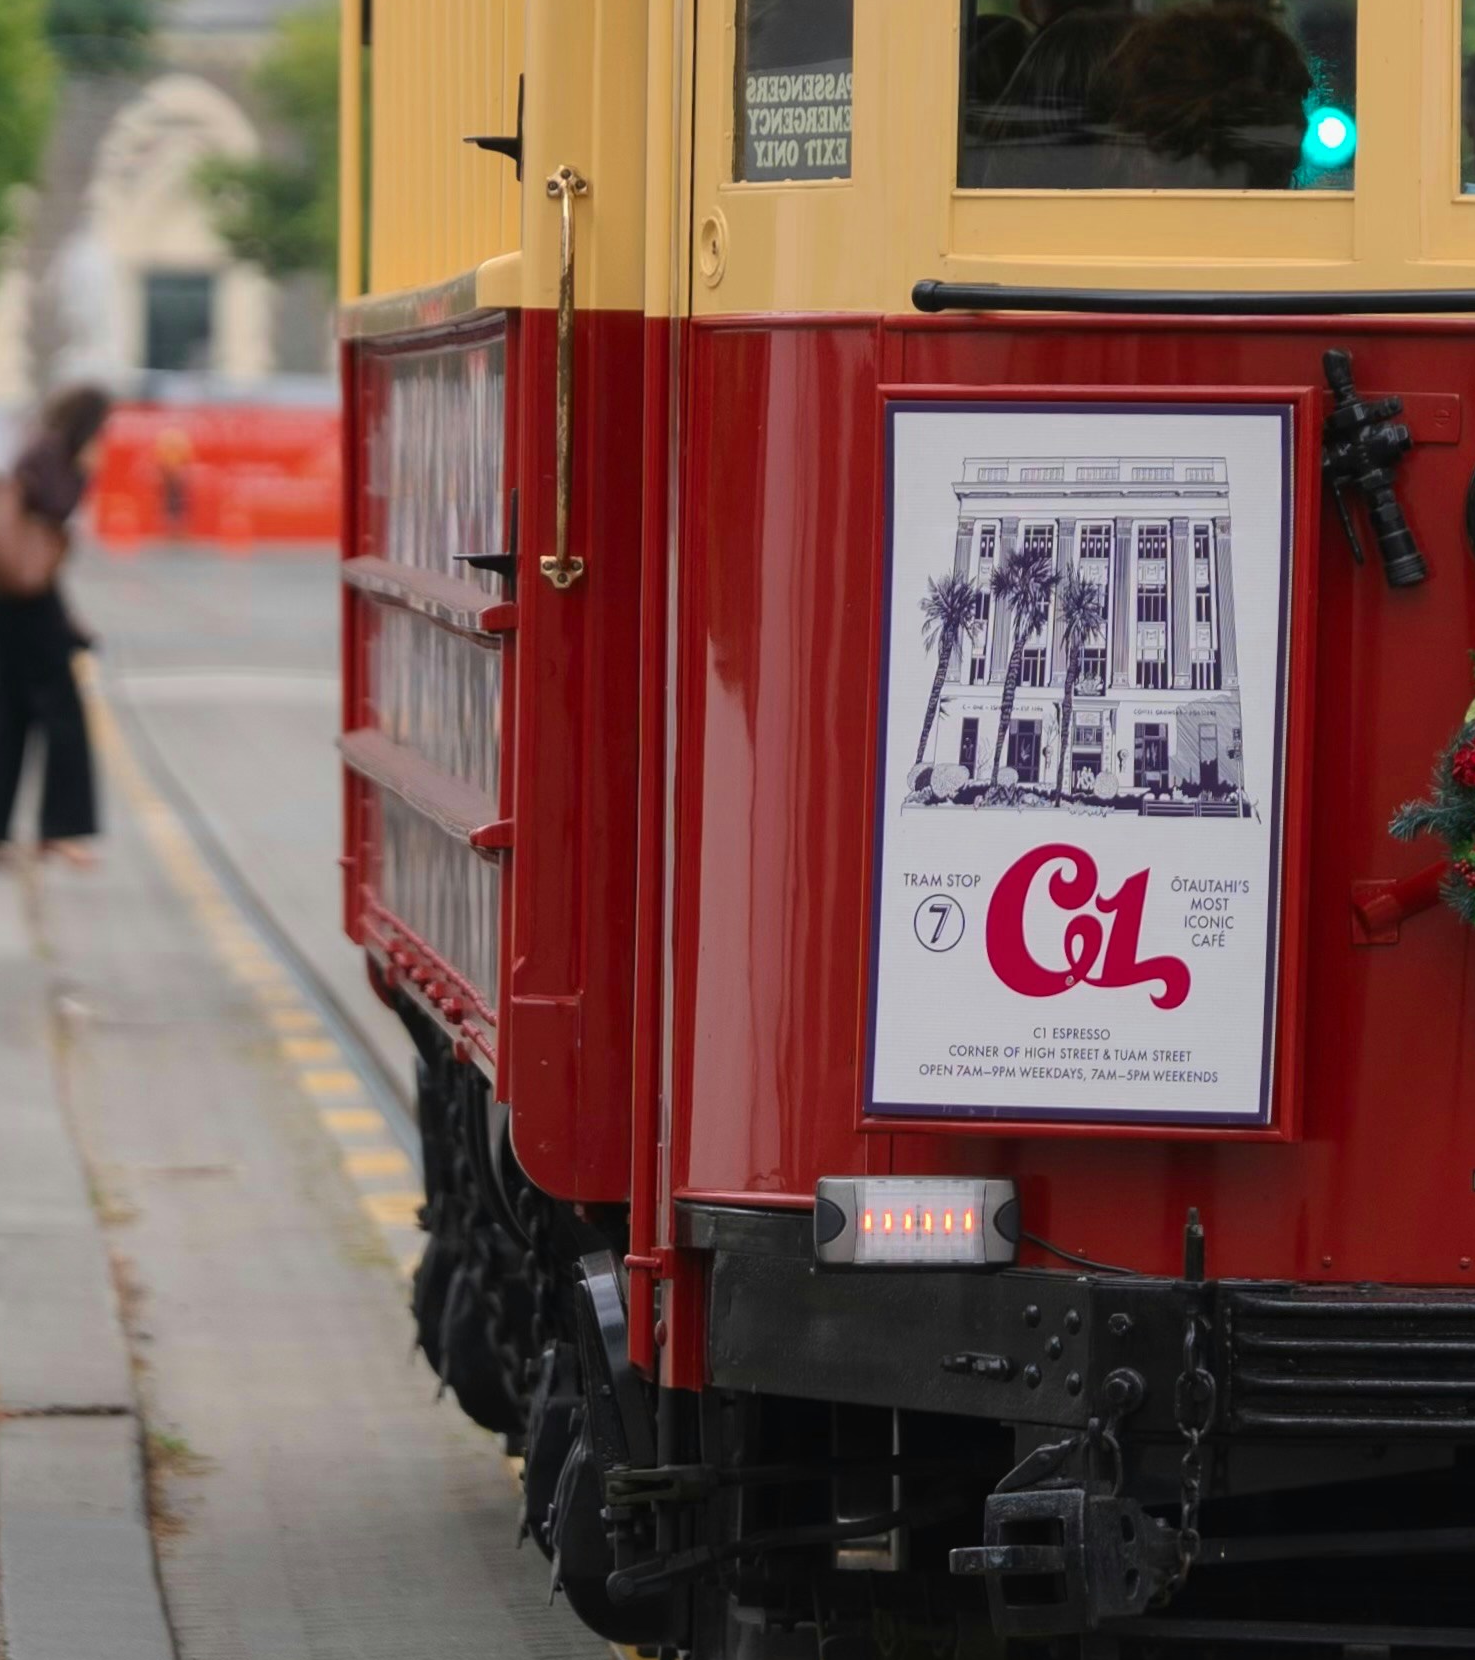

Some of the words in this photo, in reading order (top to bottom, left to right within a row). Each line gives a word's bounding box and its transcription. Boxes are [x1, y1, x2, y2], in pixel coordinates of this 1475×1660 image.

[903, 872, 942, 887] TRAM
[947, 874, 981, 888] STOP
[1190, 897, 1230, 911] MOST
[929, 903, 953, 944] 7
[1184, 915, 1235, 930] ICONIC
[1191, 931, 1225, 948] CAFÉ
[1052, 1028, 1111, 1041] ESPRESSO
[948, 1044, 999, 1057] CORNER
[1003, 1046, 1021, 1058] OF
[1024, 1046, 1055, 1059] HIGH
[1060, 1048, 1100, 1061] STREET
[1102, 1049, 1111, 1060] &
[1114, 1049, 1148, 1062] TUAM
[1152, 1050, 1192, 1062] STREET
[918, 1063, 953, 1076] OPEN
[1019, 1066, 1087, 1082] WEEKDAYS,
[1153, 1070, 1219, 1083] WEEKENDS
